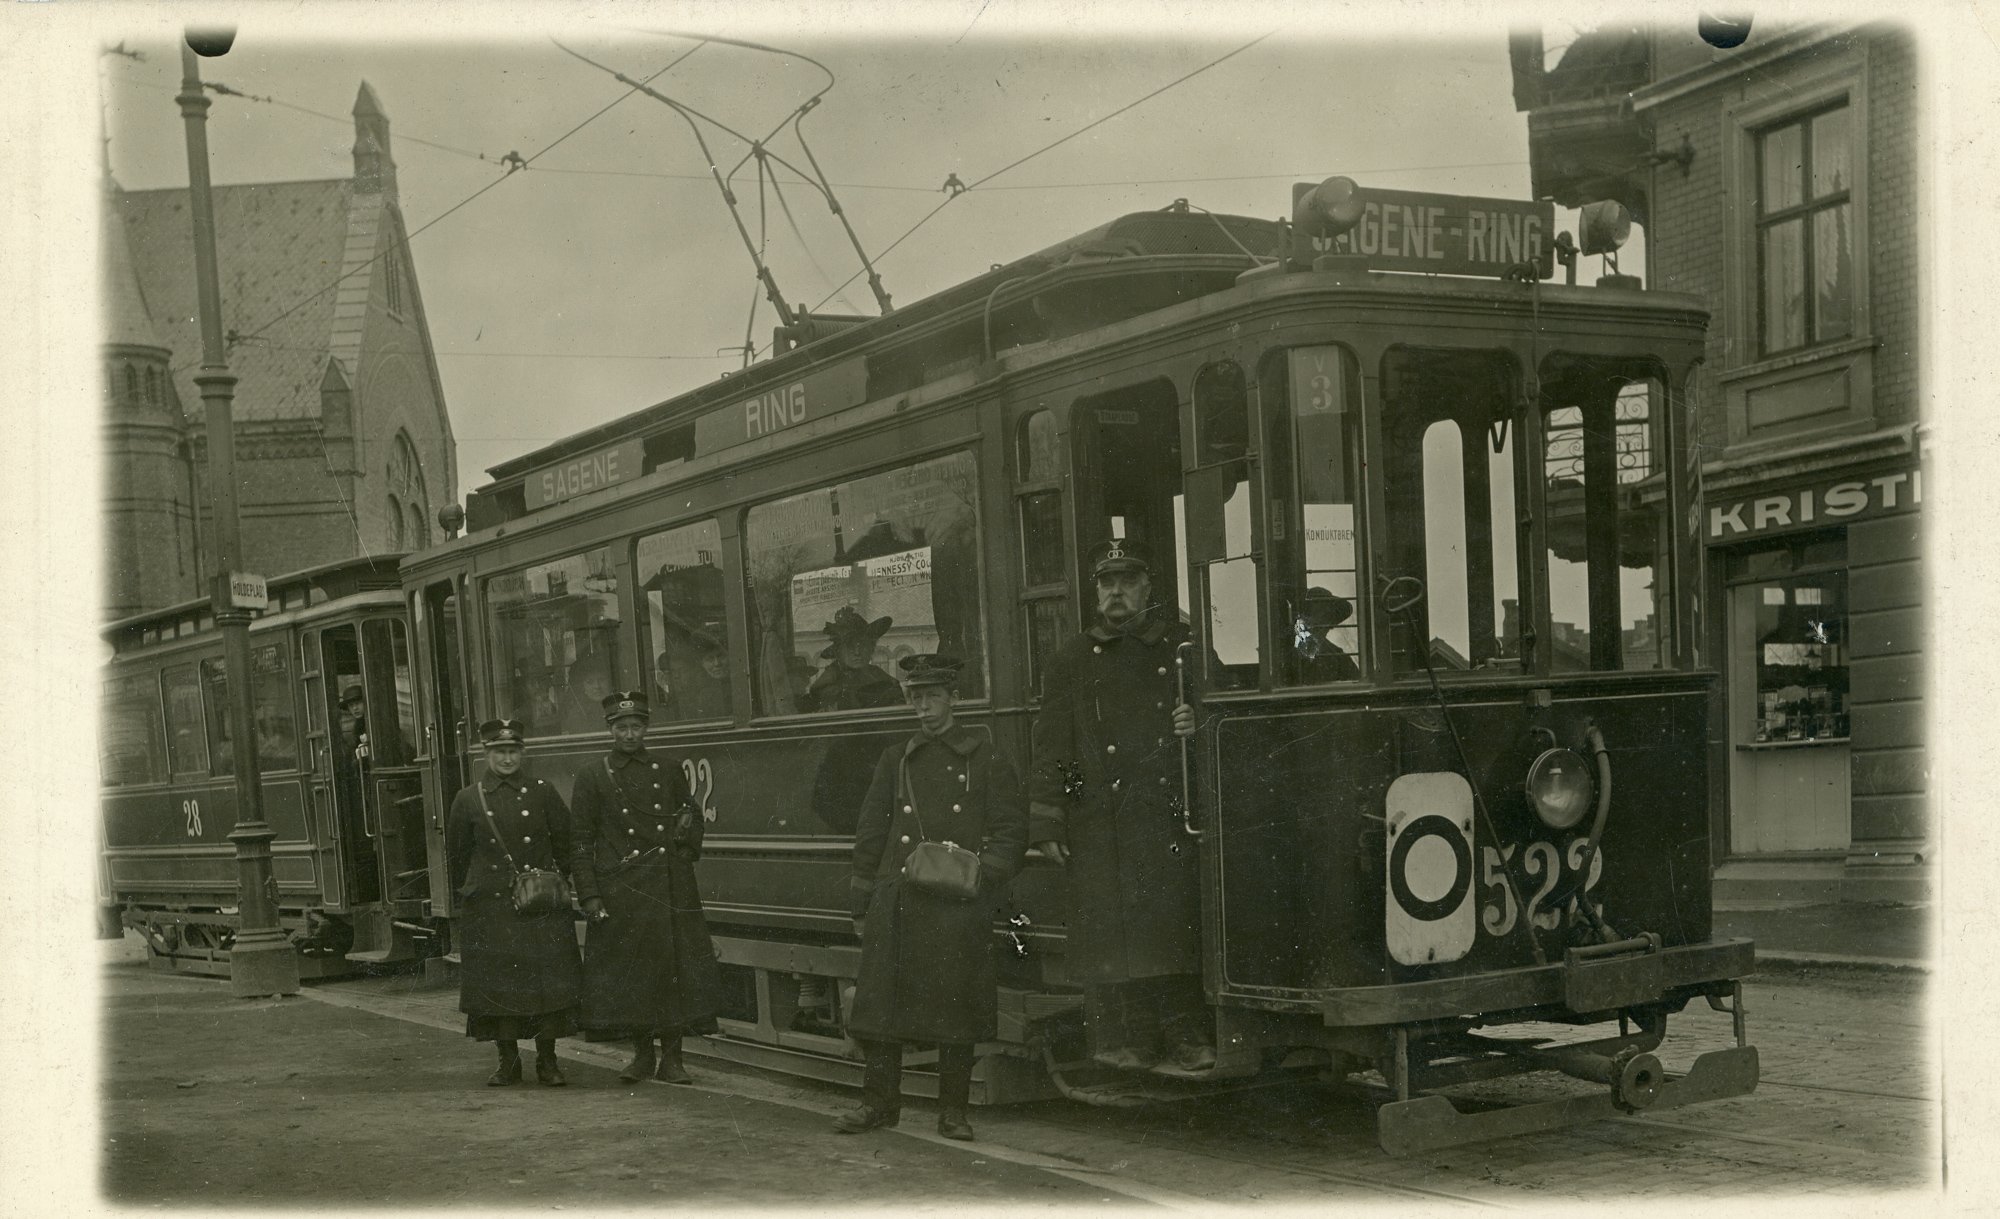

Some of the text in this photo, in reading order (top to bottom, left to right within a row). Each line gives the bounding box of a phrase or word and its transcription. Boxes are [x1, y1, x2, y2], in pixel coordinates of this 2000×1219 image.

[745, 382, 806, 439] RING
[1311, 375, 1332, 410] 3
[542, 450, 621, 502] SAGENE
[183, 799, 202, 837] 28
[1482, 837, 1603, 937] 522
